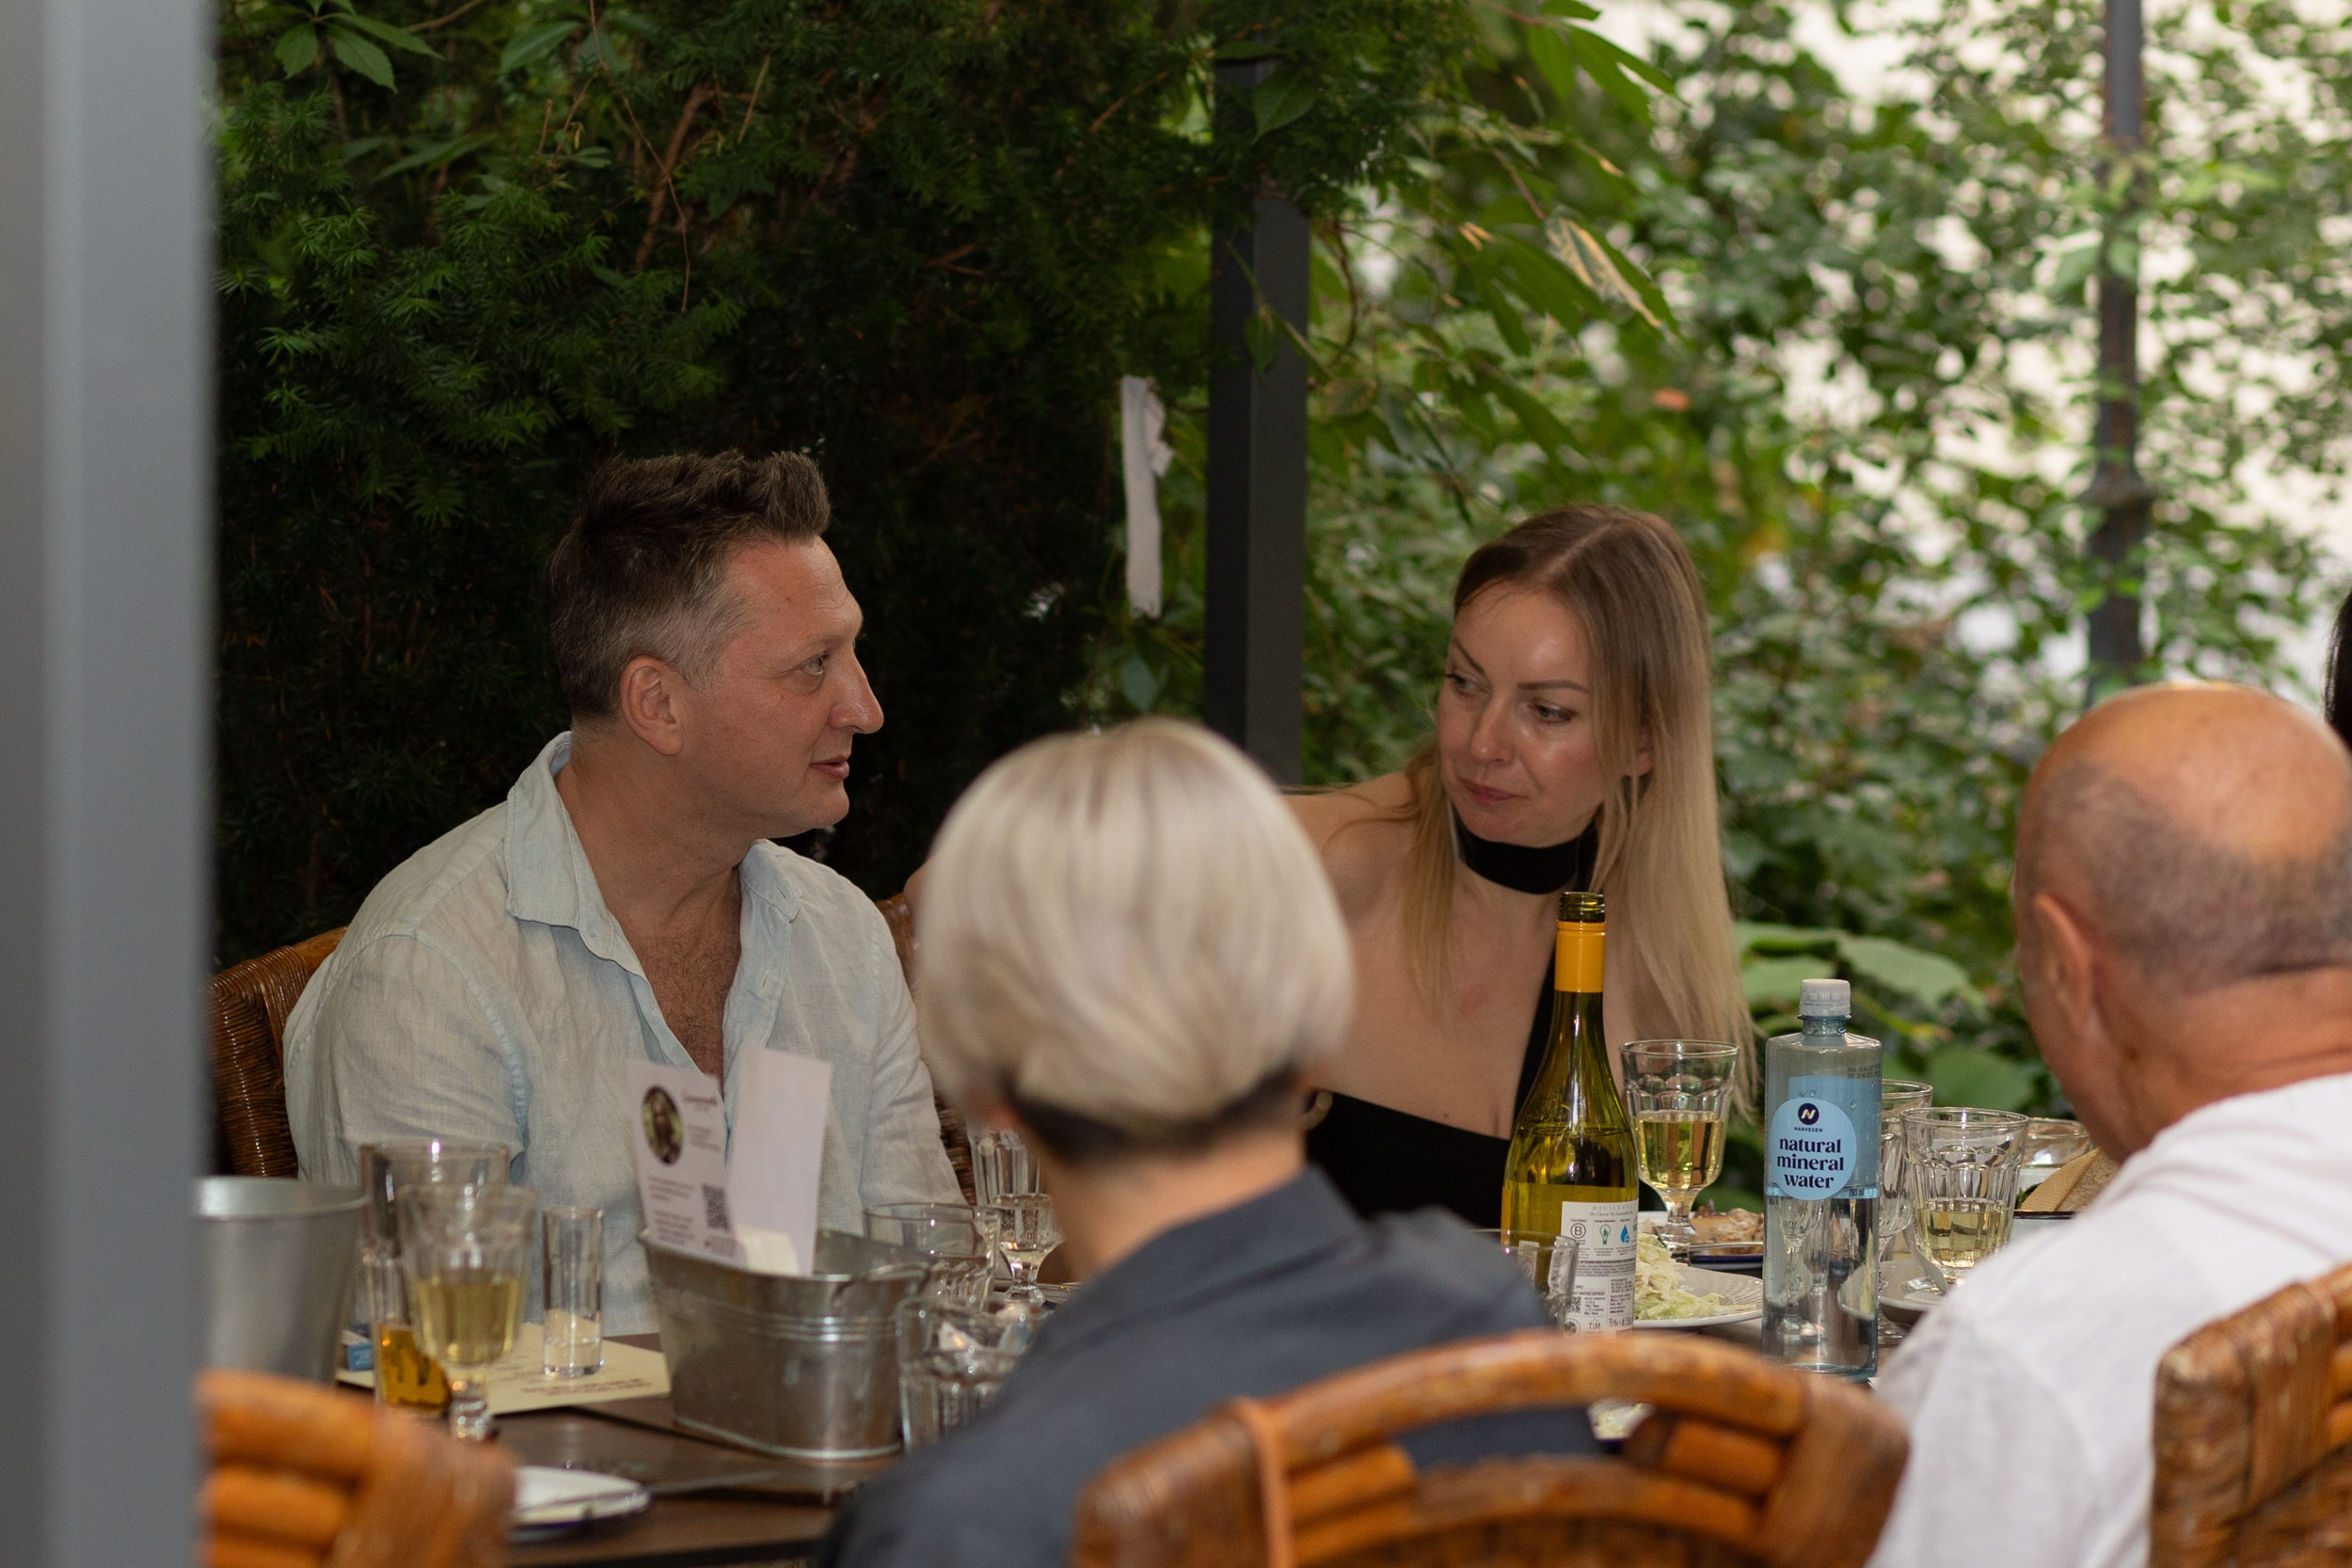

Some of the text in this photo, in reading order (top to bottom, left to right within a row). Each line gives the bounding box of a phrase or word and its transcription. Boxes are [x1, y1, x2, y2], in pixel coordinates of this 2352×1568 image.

[1779, 1138, 1841, 1153] natural
[1777, 1153, 1845, 1171] mineral
[1784, 1174, 1835, 1189] water
[1574, 1227, 1582, 1236] B
